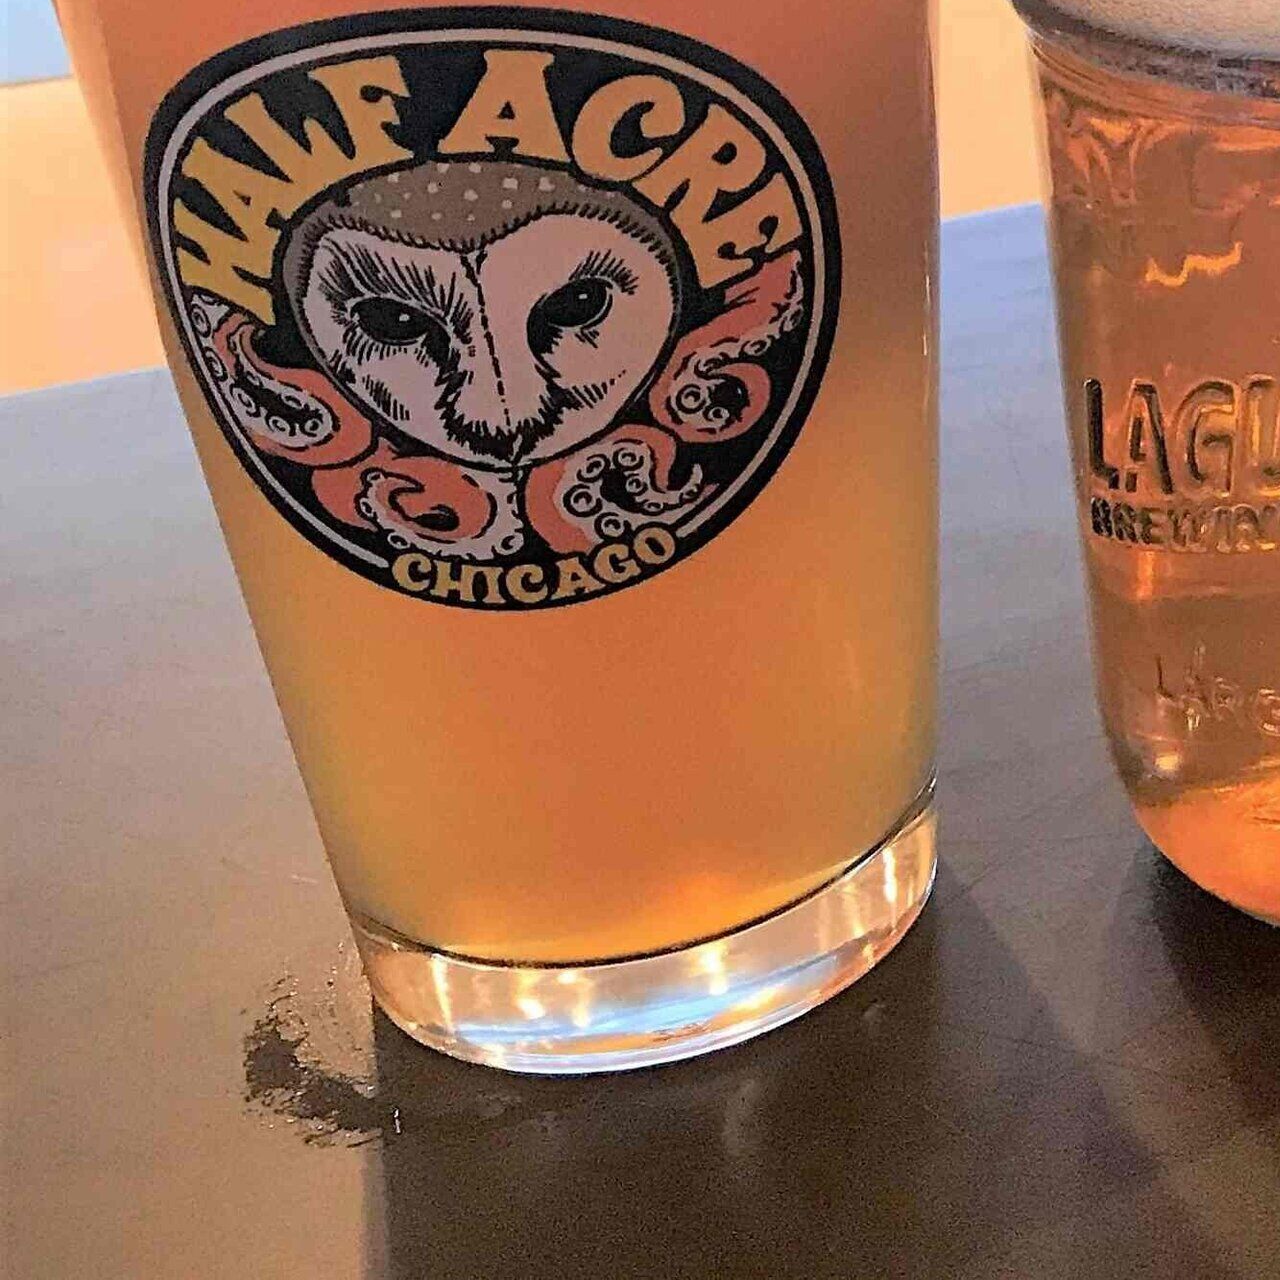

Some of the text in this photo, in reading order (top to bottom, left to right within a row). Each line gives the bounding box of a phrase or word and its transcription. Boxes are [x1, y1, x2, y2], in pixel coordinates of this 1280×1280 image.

[171, 49, 805, 326] HALF ACRE
[392, 527, 677, 605] CHICAGO
